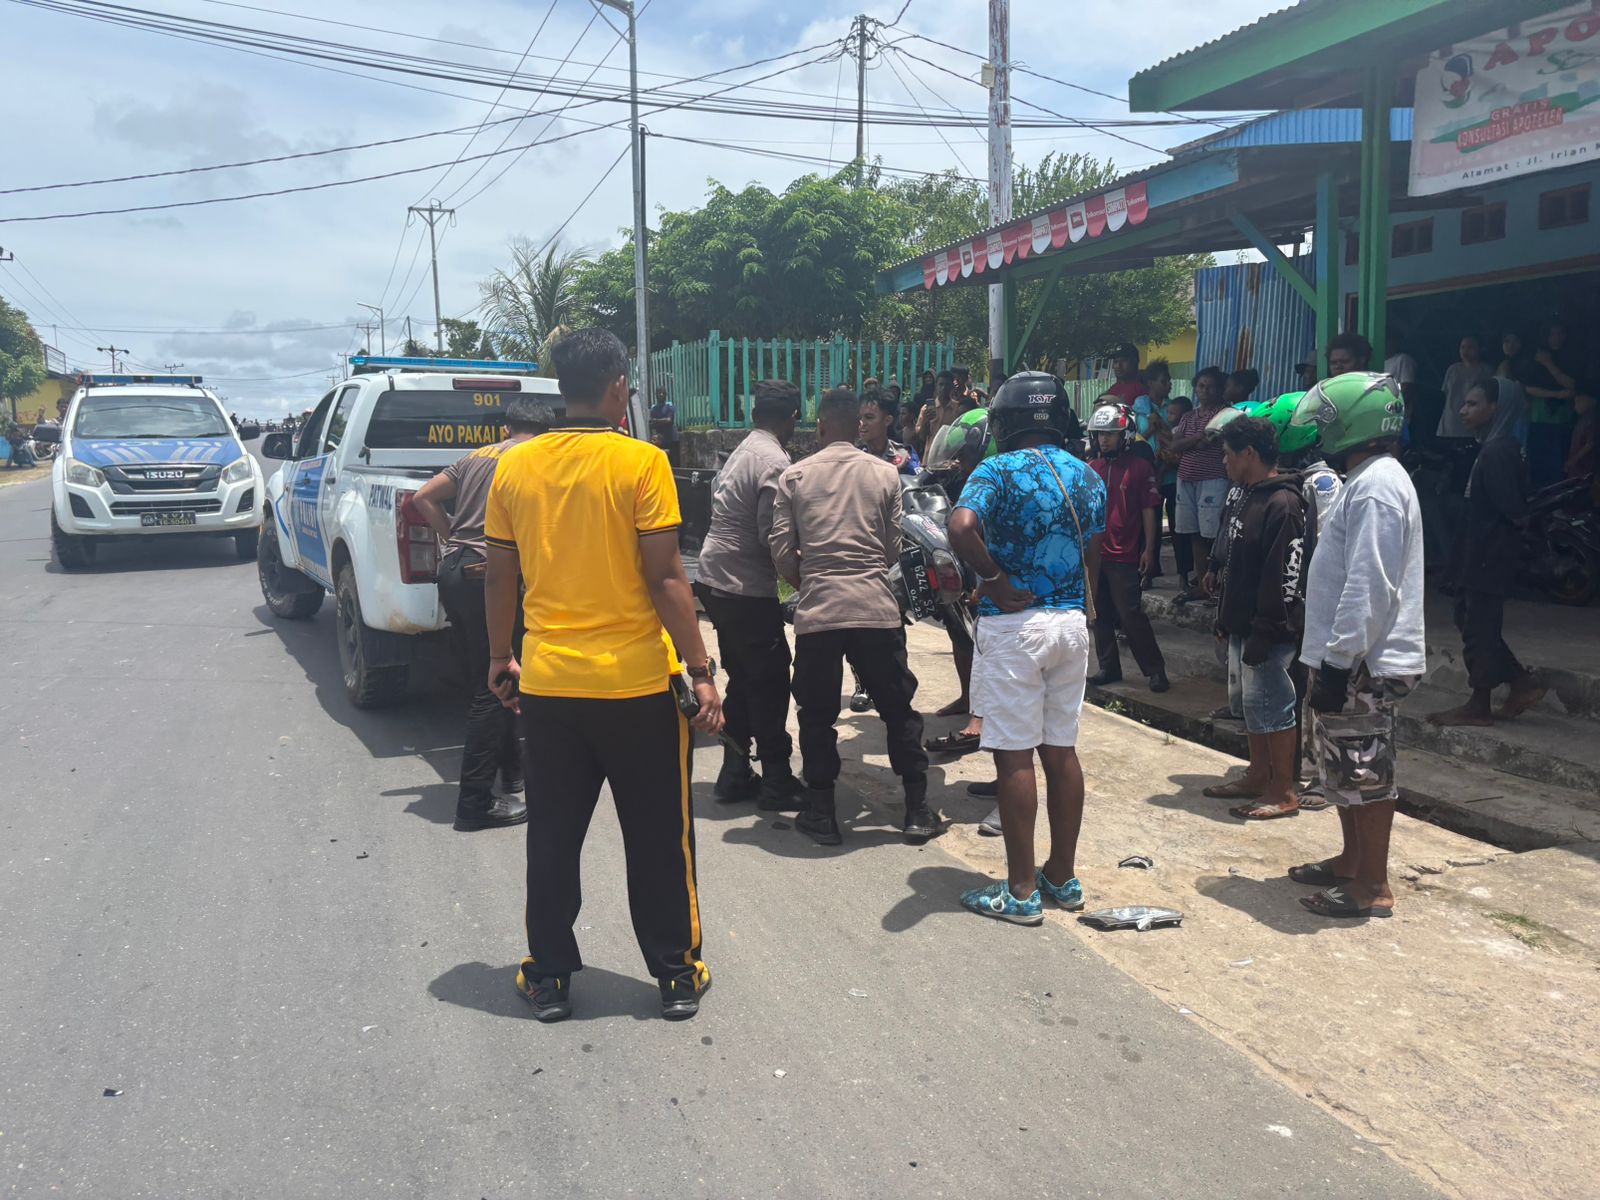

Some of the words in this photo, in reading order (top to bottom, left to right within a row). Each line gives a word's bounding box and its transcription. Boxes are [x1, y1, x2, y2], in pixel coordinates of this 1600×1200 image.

[1491, 99, 1550, 121] GRATIS
[1462, 163, 1509, 180] Alamat
[473, 392, 502, 407] 901
[1028, 394, 1057, 404] KYT
[428, 424, 454, 443] AYO
[457, 424, 496, 443] PAKAI
[146, 470, 185, 479] ISUZU
[914, 564, 929, 593] 6242
[923, 599, 936, 614] SZ
